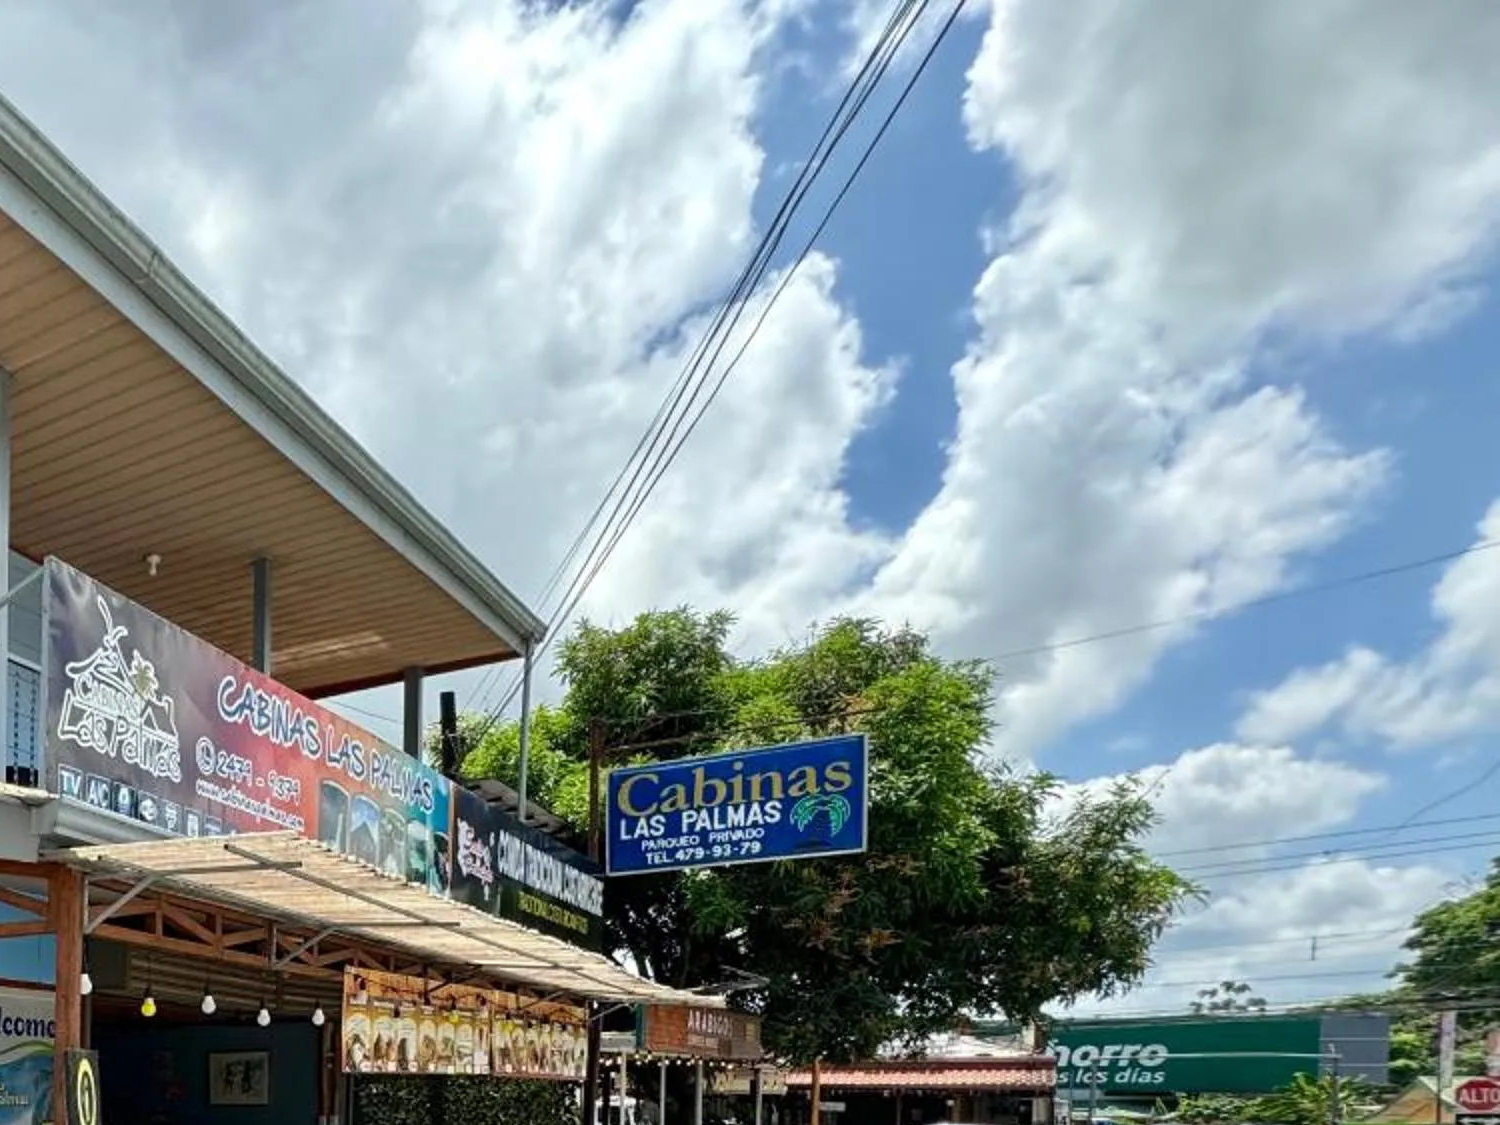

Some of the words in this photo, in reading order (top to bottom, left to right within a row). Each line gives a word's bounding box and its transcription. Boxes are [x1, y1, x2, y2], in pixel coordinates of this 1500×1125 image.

[217, 675, 322, 760] CABINAS
[326, 724, 367, 783] LAS
[369, 748, 434, 815] PALMAS
[617, 760, 852, 817] Cabinas
[620, 814, 665, 840] LAS
[681, 801, 783, 833] PALMAS
[641, 834, 700, 851] PARQUEO
[708, 827, 765, 844] PRIVADO
[1459, 1087, 1500, 1104] ALTO
